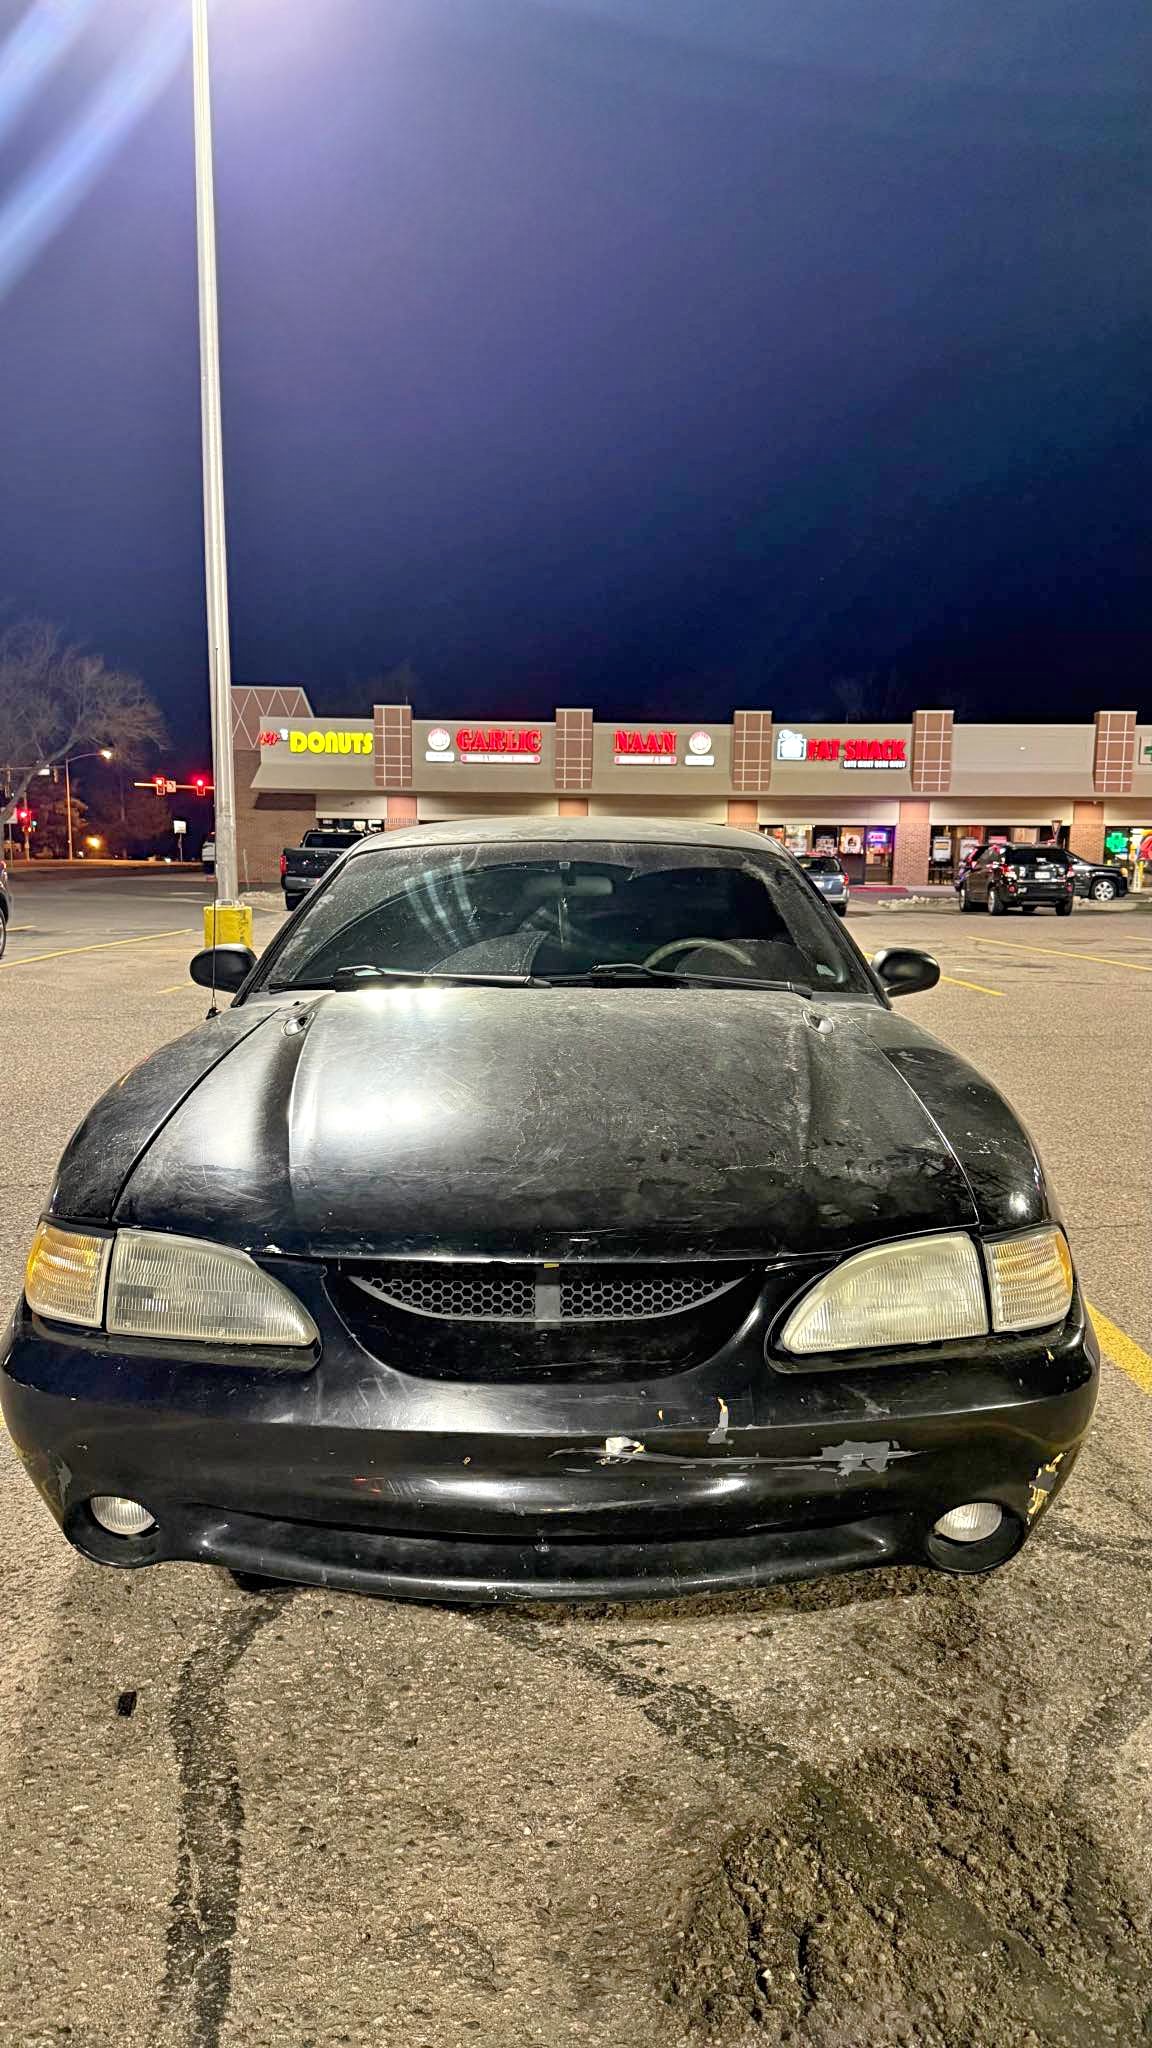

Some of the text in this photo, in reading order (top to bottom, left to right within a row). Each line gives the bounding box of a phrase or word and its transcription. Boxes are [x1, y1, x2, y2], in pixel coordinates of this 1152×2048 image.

[289, 731, 373, 754] DONUTS
[456, 728, 542, 752] GARLIC
[614, 730, 677, 753] NAAN
[806, 738, 907, 760] FAT SHACK
